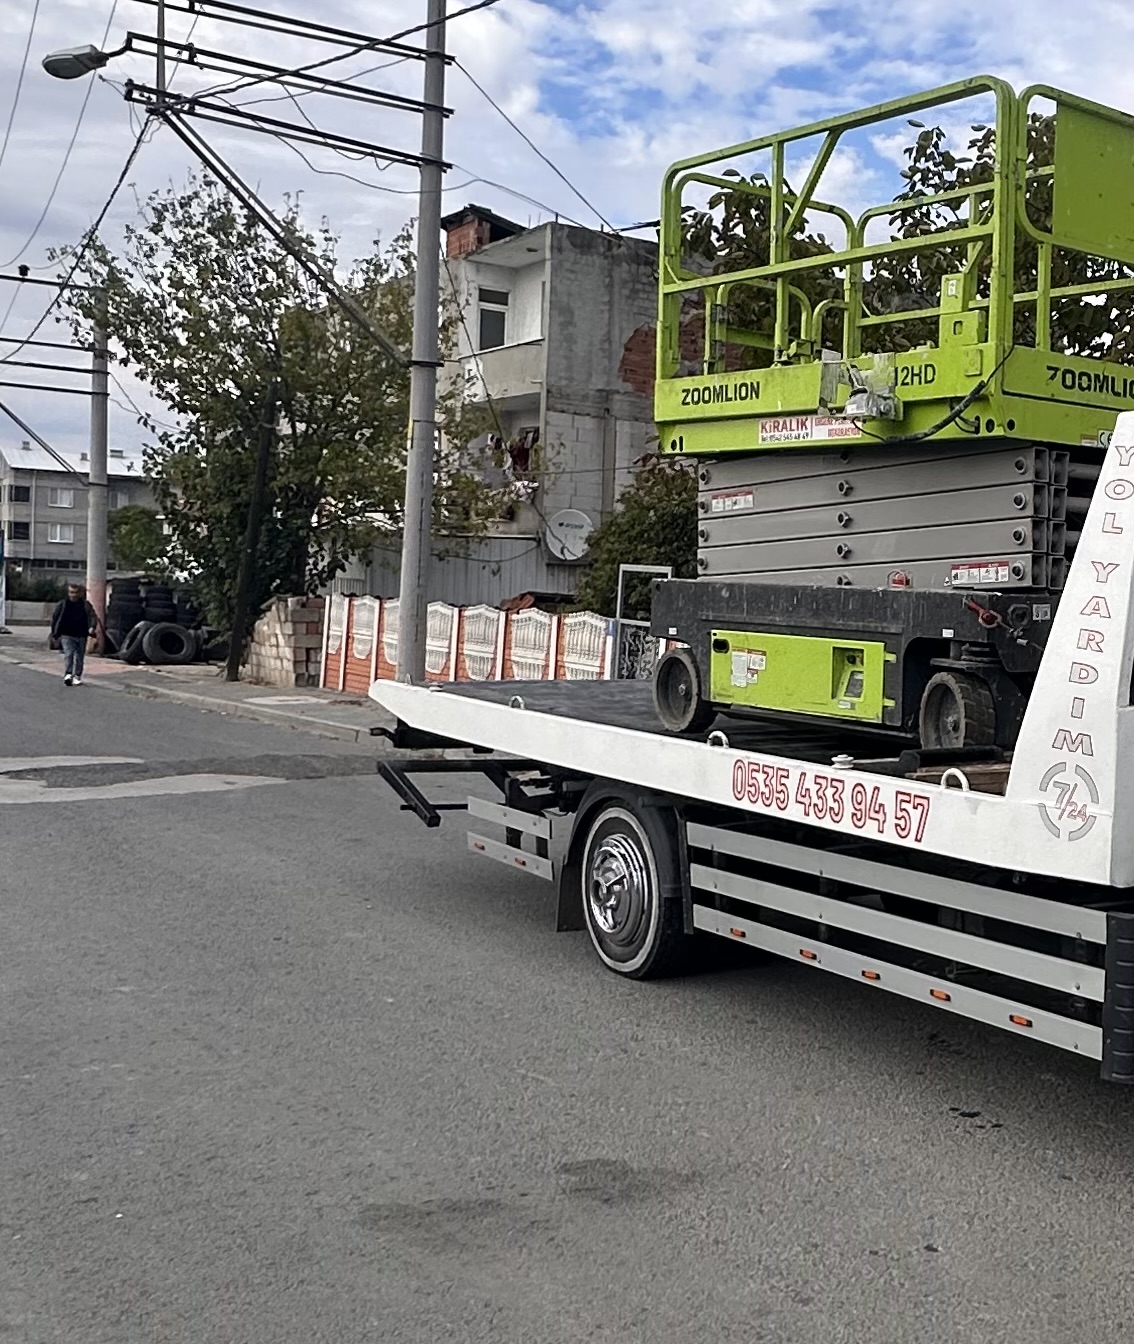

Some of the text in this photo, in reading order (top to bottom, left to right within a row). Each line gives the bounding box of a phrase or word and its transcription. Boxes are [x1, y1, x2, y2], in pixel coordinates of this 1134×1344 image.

[681, 381, 760, 406] ZOOMLION
[1052, 560, 1121, 757] YARDIM
[732, 759, 931, 843] 0535 433 94 57
[1052, 780, 1088, 822] 7/24
